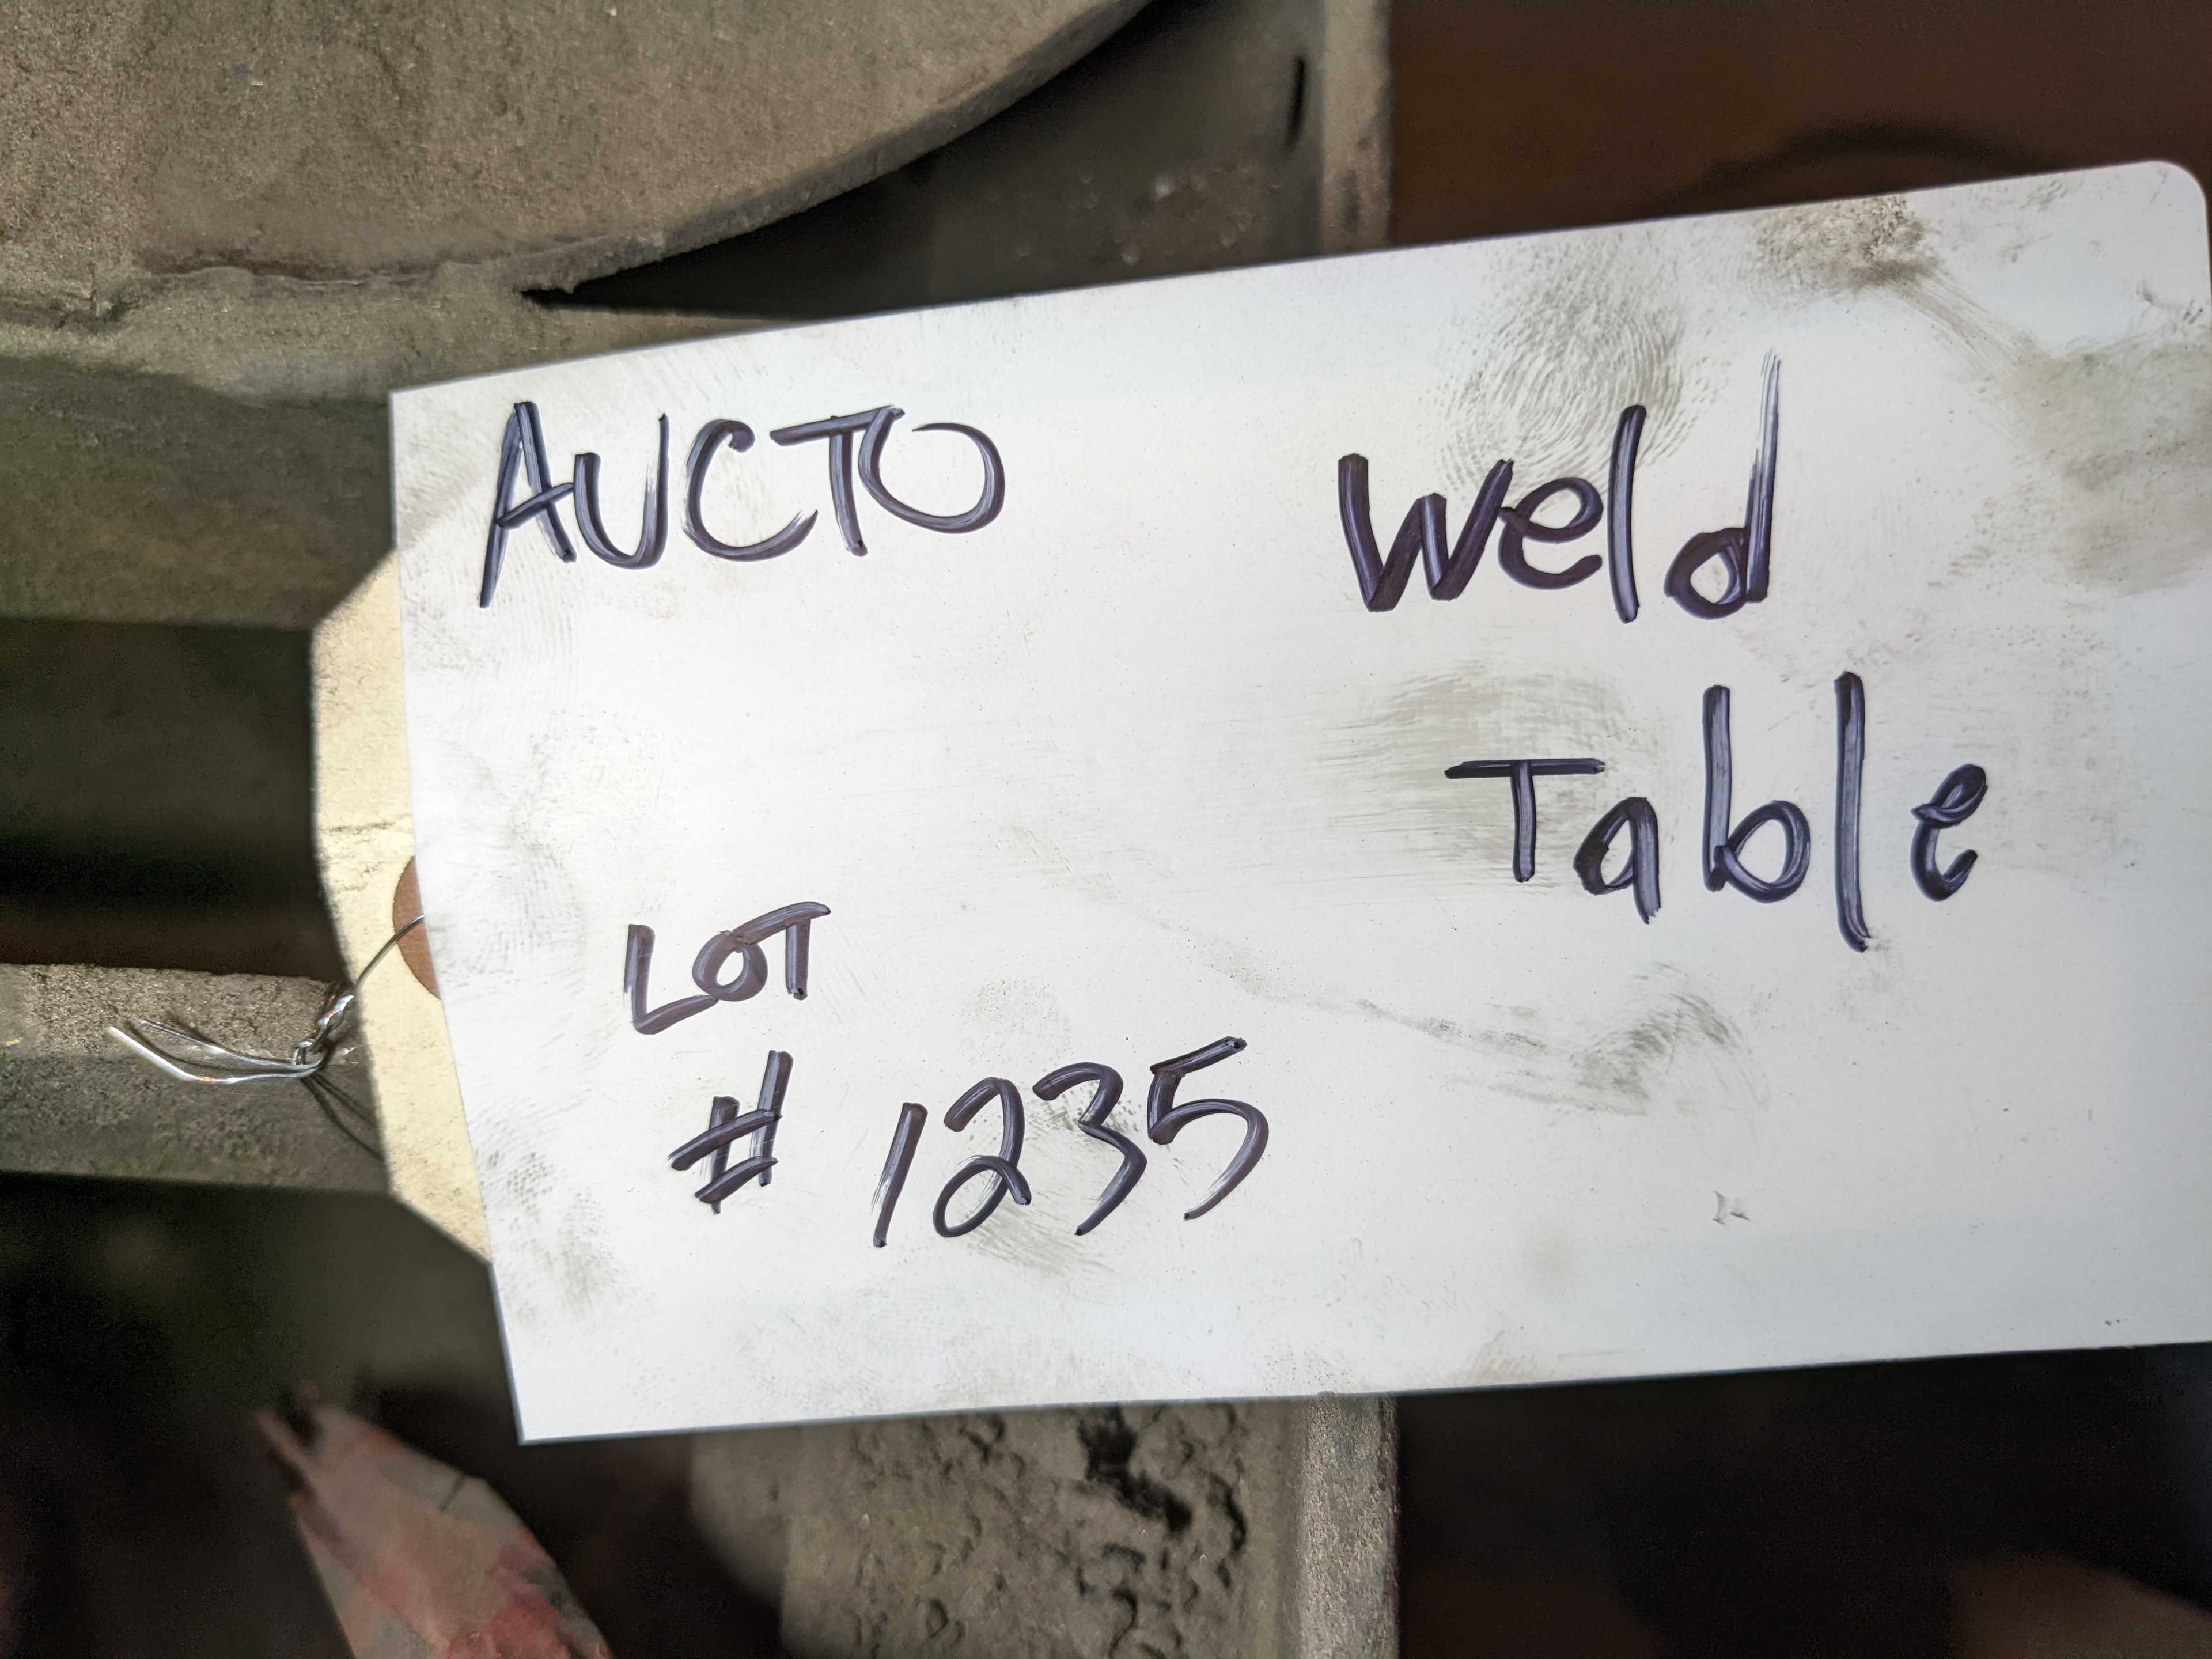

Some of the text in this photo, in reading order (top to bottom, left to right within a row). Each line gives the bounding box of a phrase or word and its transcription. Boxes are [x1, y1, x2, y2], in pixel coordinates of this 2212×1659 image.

[479, 400, 1006, 608] AUCTO
[1338, 349, 1781, 623] Weld
[1444, 671, 1988, 953] Table
